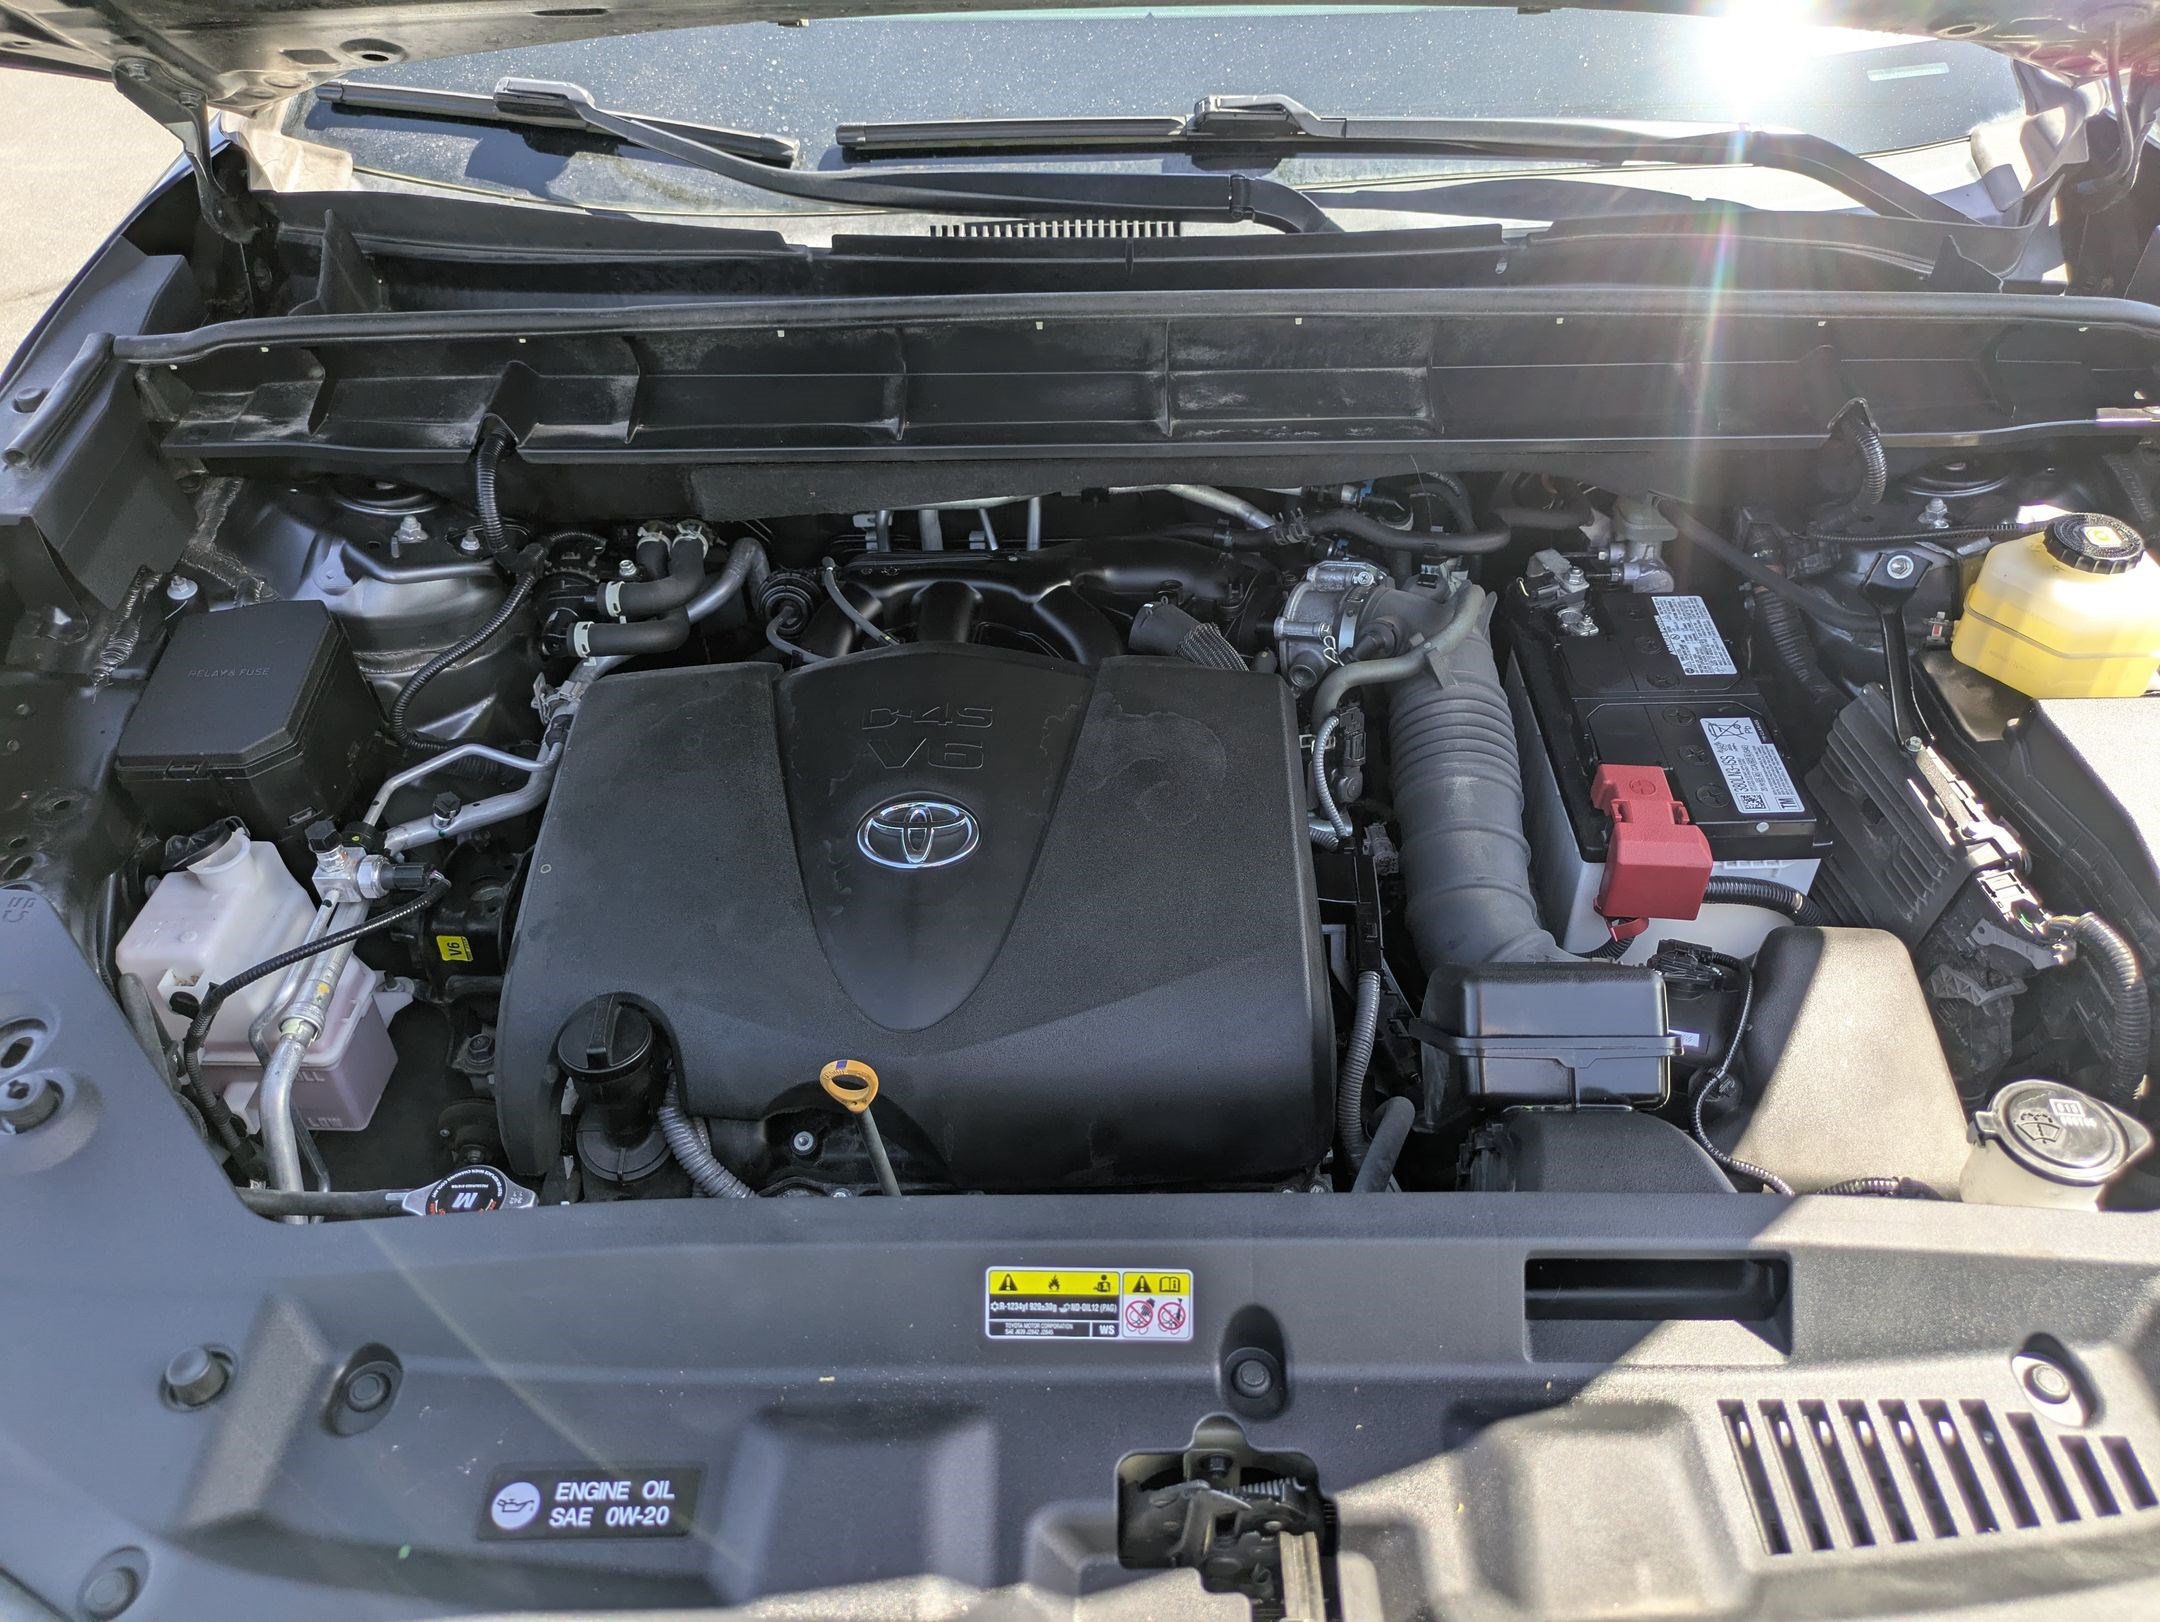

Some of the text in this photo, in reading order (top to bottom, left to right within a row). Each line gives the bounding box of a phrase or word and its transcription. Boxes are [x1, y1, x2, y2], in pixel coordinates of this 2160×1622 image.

[862, 702, 993, 729] D-4S
[865, 738, 984, 770] V6
[447, 942, 462, 956] V6
[307, 1117, 343, 1128] LOW
[1100, 1303, 1118, 1313] (PAG)
[1099, 1325, 1116, 1336] WS
[554, 1480, 676, 1501] ENGINE OIL
[549, 1506, 670, 1527] SAE 0W-20
